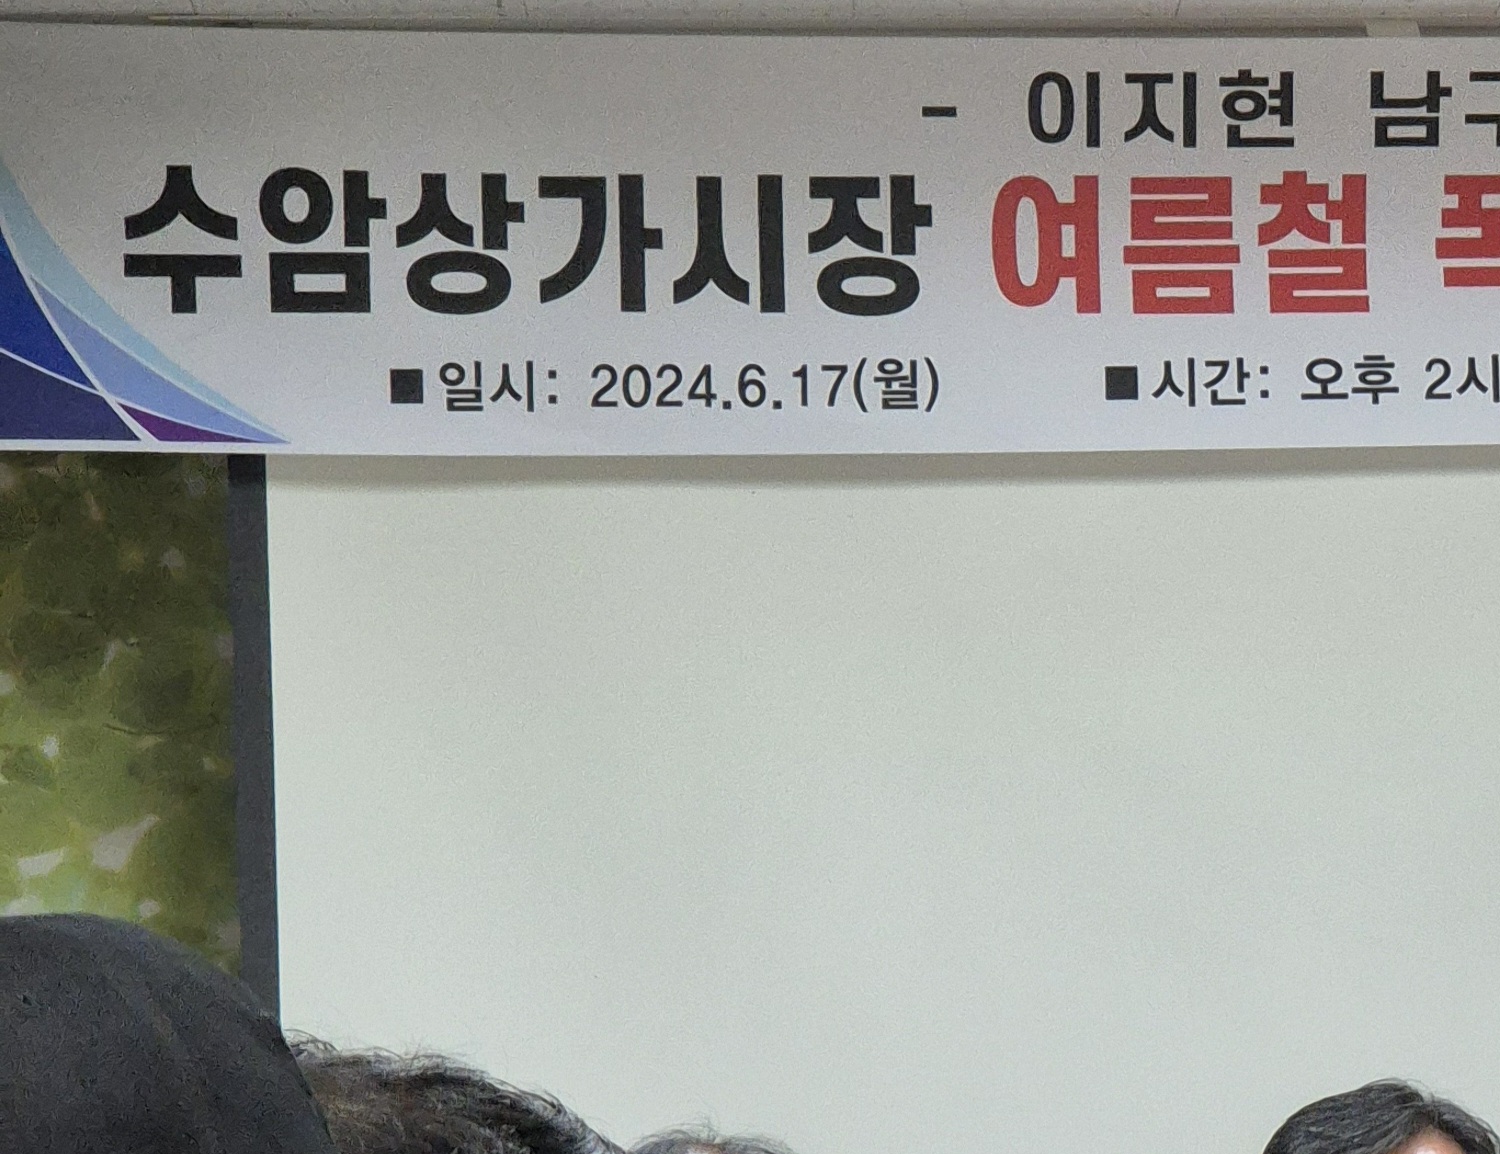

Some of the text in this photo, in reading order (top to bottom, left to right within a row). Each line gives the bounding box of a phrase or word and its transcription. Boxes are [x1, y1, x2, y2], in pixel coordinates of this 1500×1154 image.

[1027, 68, 1295, 148] 이지현
[123, 164, 933, 317] 수암상가시장
[991, 170, 1370, 315] 여름철
[439, 357, 939, 413] 일시: 2024.6.17(월)
[1151, 354, 1500, 407] 시간: 오후 2시
